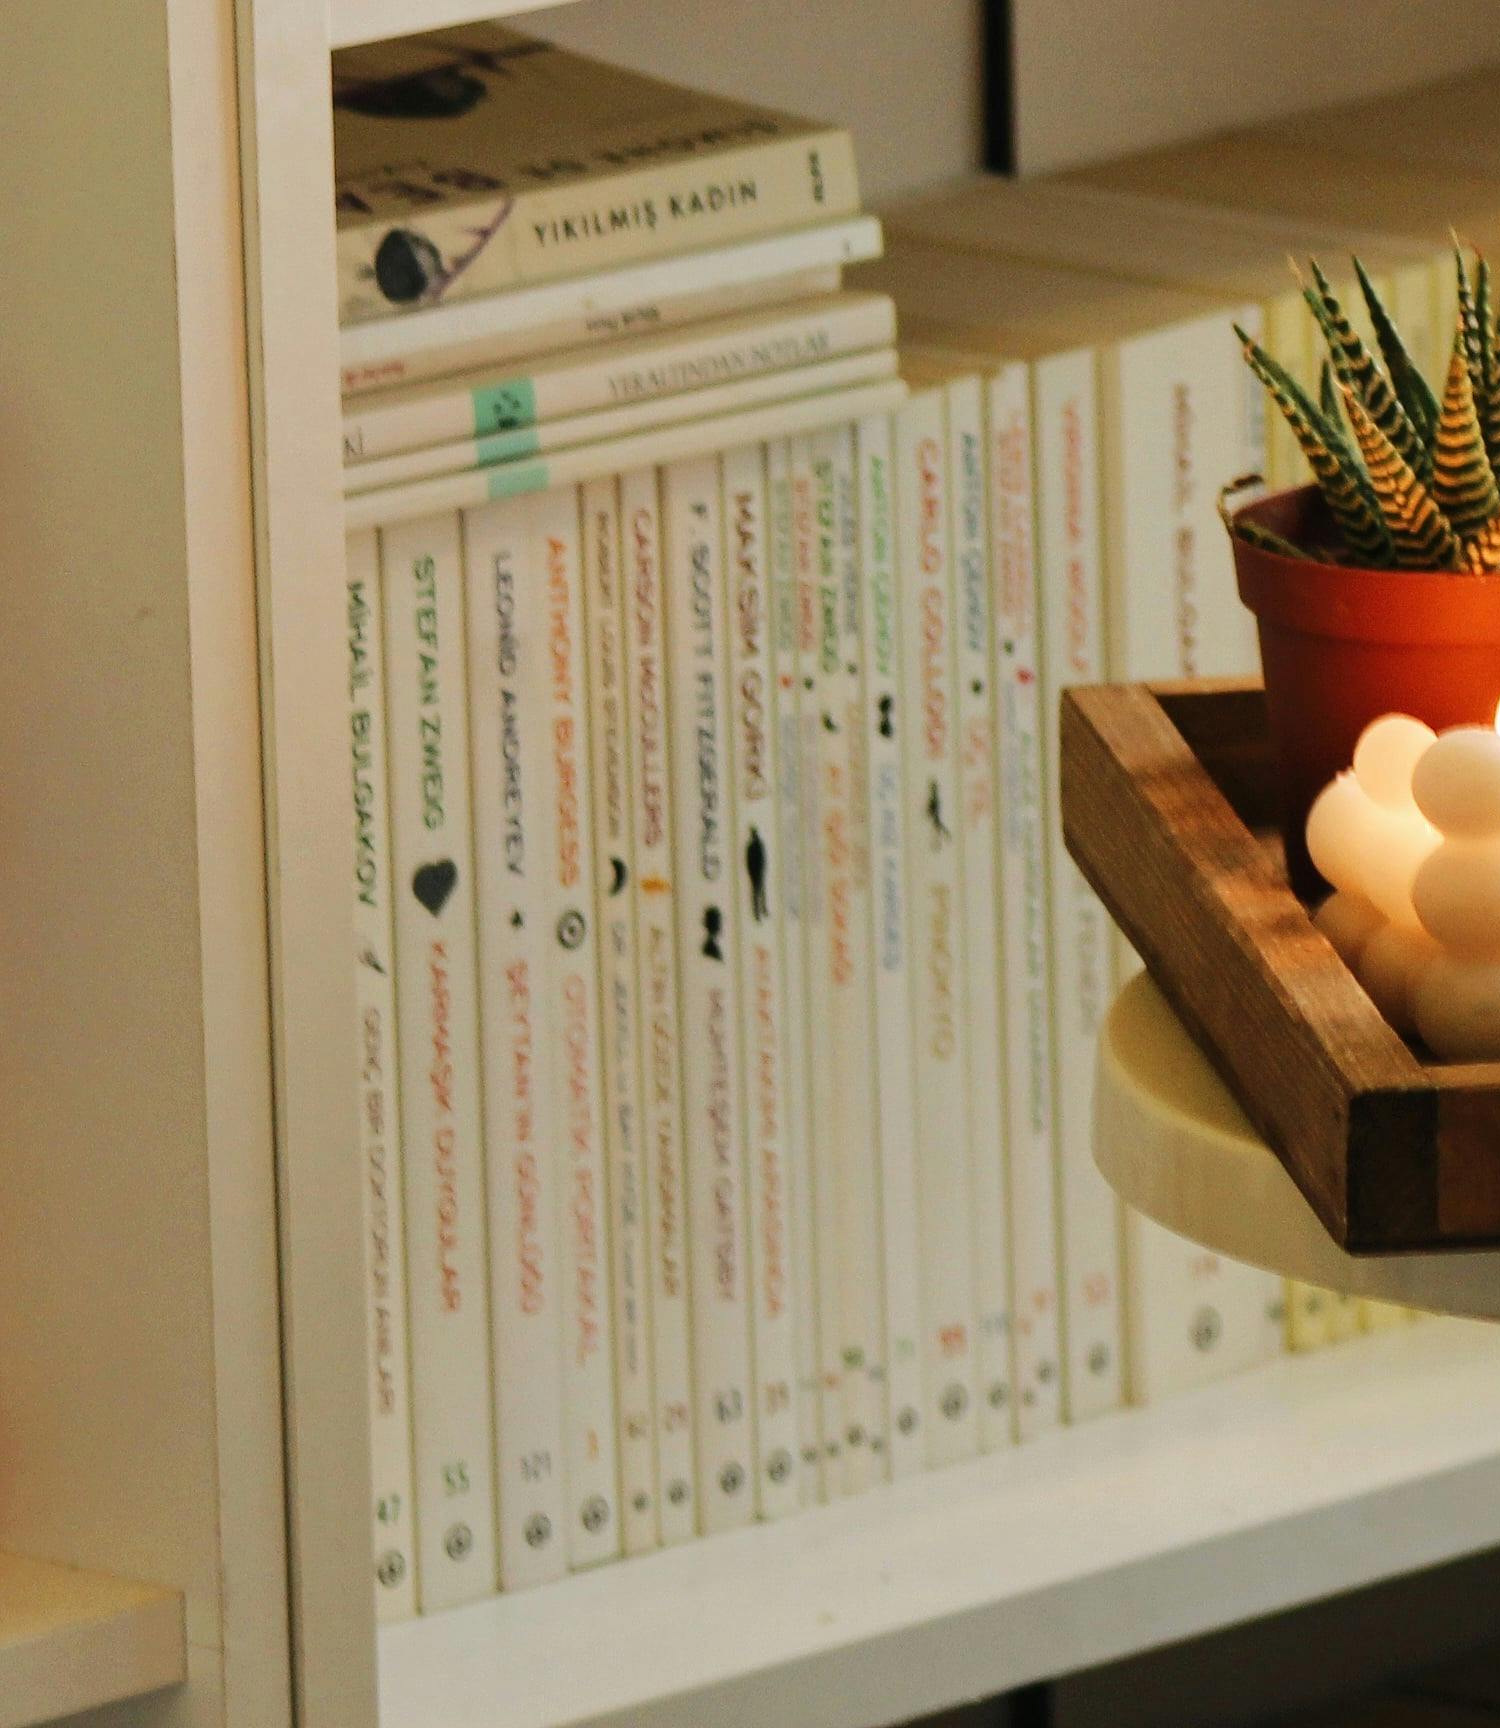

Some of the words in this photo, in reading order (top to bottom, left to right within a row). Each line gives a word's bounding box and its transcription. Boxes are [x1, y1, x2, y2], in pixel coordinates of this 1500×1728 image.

[533, 198, 657, 247] YIKILMIŞ
[669, 179, 757, 218] KADIN
[815, 460, 836, 578] STEFAN
[916, 438, 942, 576] CARLO
[962, 433, 981, 540] ANTON
[414, 556, 440, 705] STEFAN
[546, 537, 569, 703] ANTHONY
[634, 508, 656, 646] CARSON
[692, 544, 714, 659] SCOTT
[351, 711, 378, 908] BULGAKOV
[419, 716, 446, 831] ZWEIG
[500, 689, 524, 877] ANDREYEV
[554, 717, 580, 887] BURGESS
[696, 672, 723, 880] FITZGERALD
[573, 1169, 598, 1369] PORTAKAL
